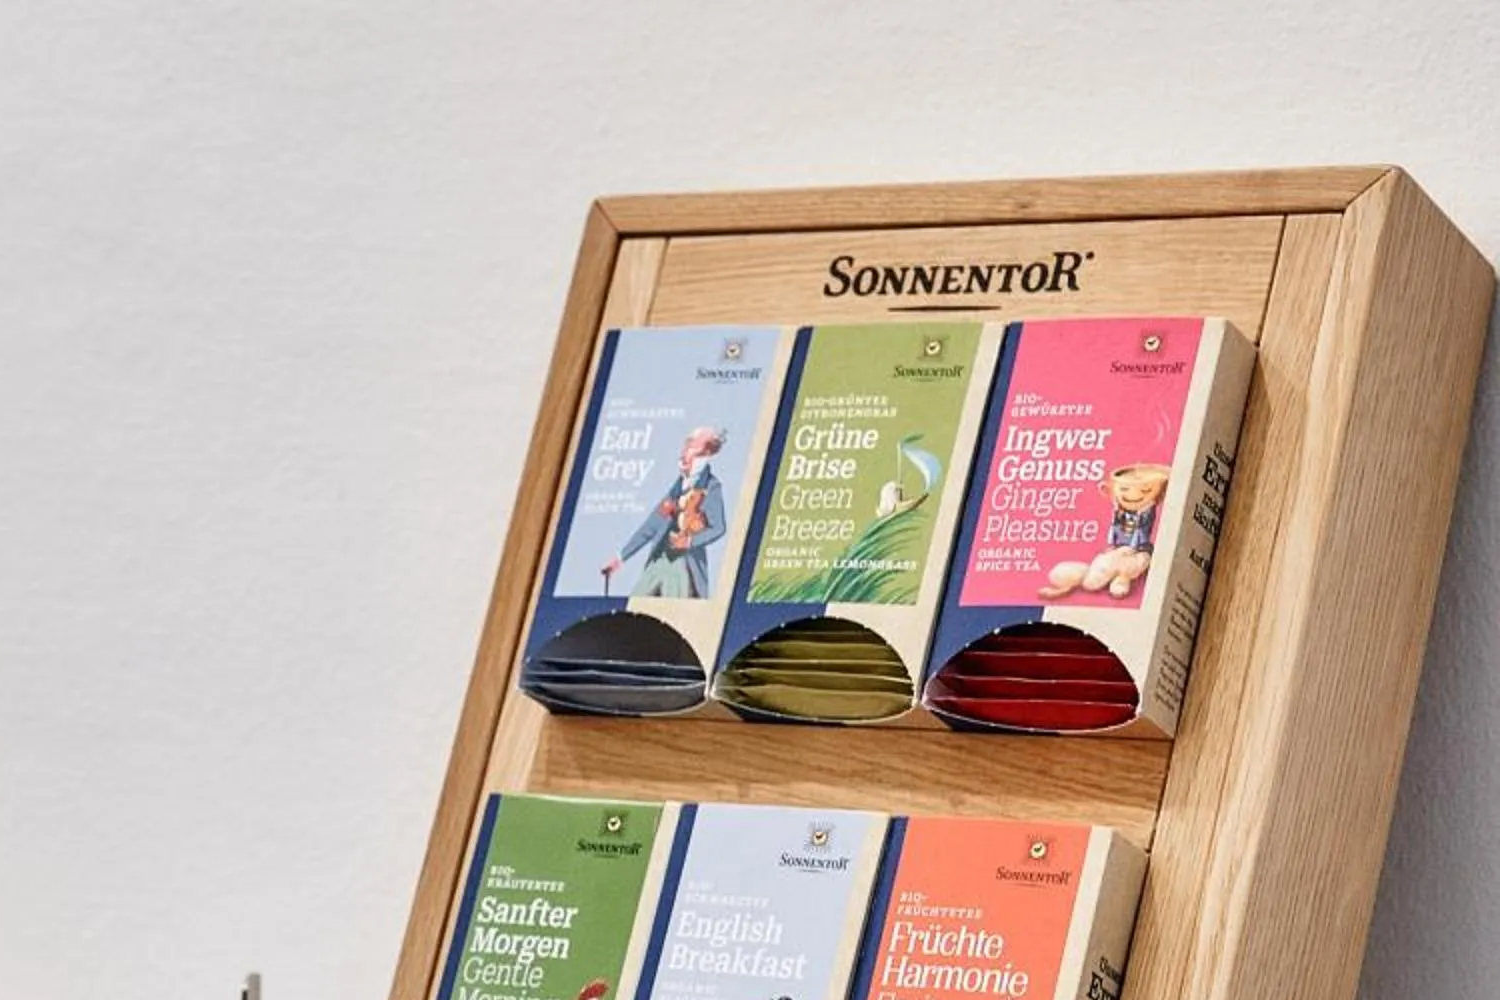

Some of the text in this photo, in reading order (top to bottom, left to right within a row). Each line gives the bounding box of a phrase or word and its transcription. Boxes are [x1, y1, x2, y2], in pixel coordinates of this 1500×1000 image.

[601, 423, 653, 450] Earl
[794, 423, 879, 450] Grüne
[1003, 425, 1112, 458] Ingwer
[593, 454, 654, 487] Grey
[786, 453, 857, 481] Brise
[997, 455, 1106, 482] Genuss
[779, 484, 853, 510] Green
[990, 482, 1084, 516] Ginger
[771, 515, 856, 541] Breeze
[982, 514, 1100, 543] Pleasure
[806, 559, 830, 569] TEA
[978, 547, 1037, 560] ORGANIC
[1014, 560, 1041, 572] TEA
[477, 896, 579, 928] Sanfter
[676, 910, 784, 947] English
[888, 920, 1005, 959] Früchte
[470, 927, 570, 963] Morgen
[463, 956, 544, 987] Gentle
[668, 943, 809, 980] Breakfast
[880, 955, 1030, 997] Harmonie
